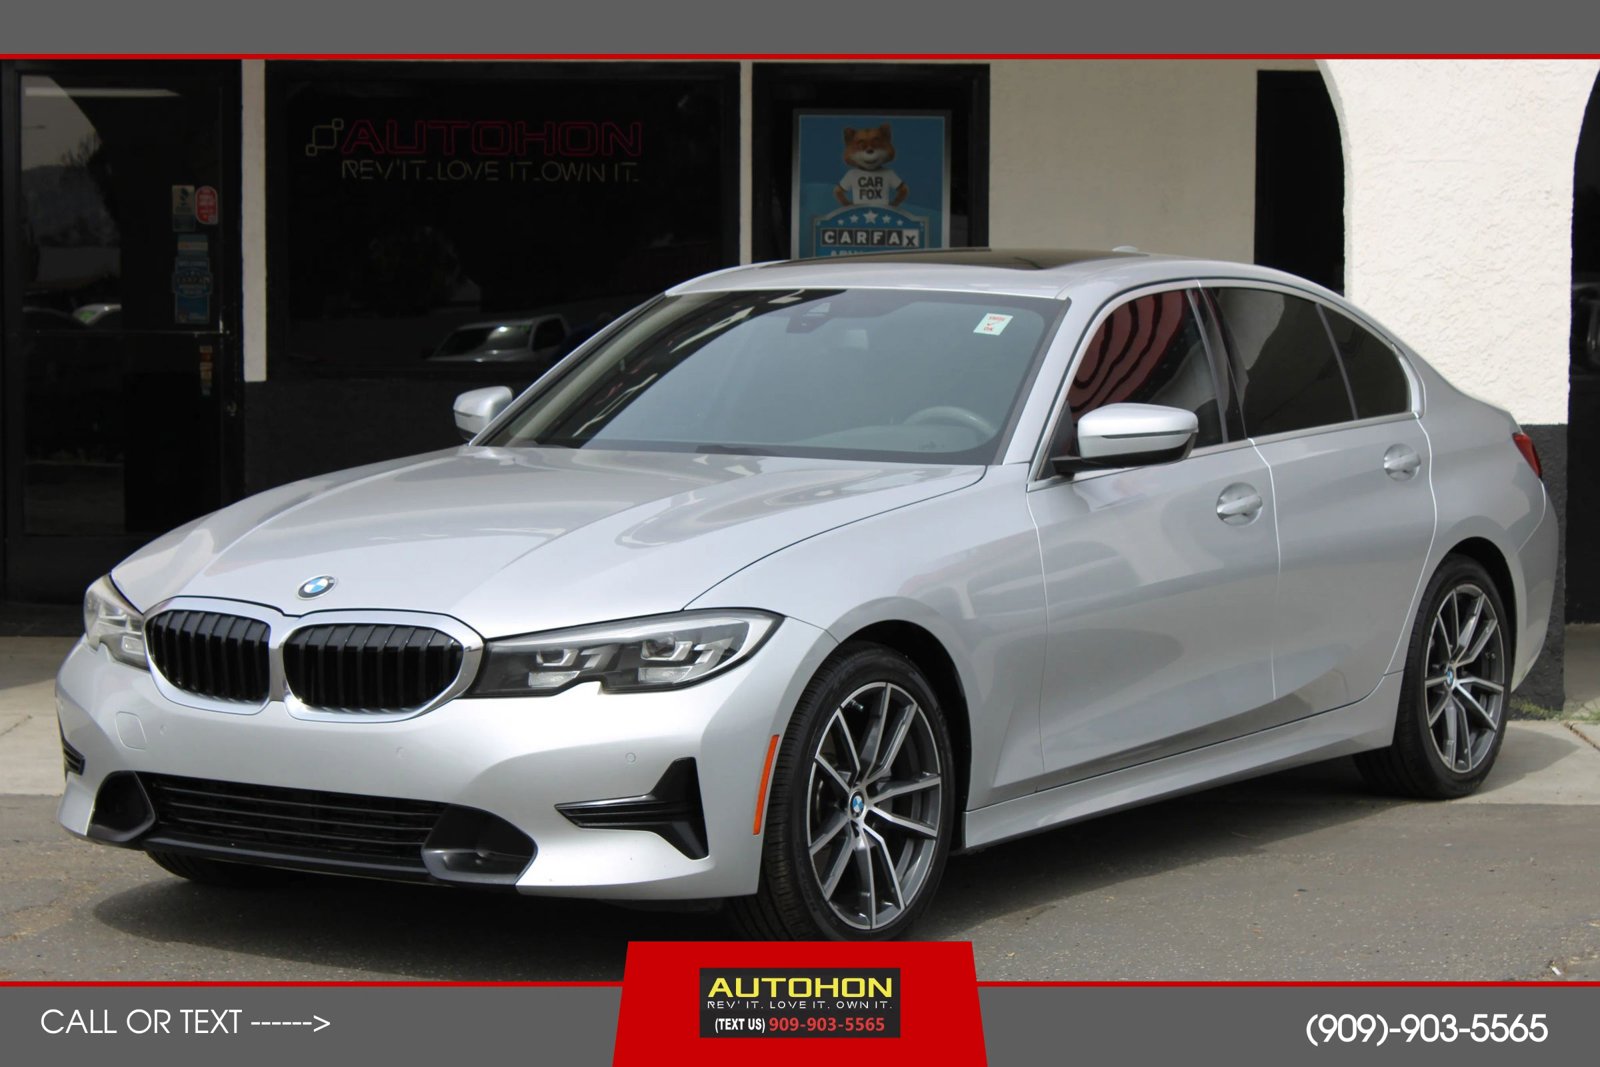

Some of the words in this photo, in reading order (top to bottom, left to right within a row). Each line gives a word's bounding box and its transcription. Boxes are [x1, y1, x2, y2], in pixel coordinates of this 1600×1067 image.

[340, 120, 643, 157] AUTOHON
[436, 160, 499, 181] LOVE
[541, 161, 605, 182] OWN
[857, 176, 884, 188] CAR
[859, 188, 883, 200] FOX
[823, 230, 919, 247] CARFAX
